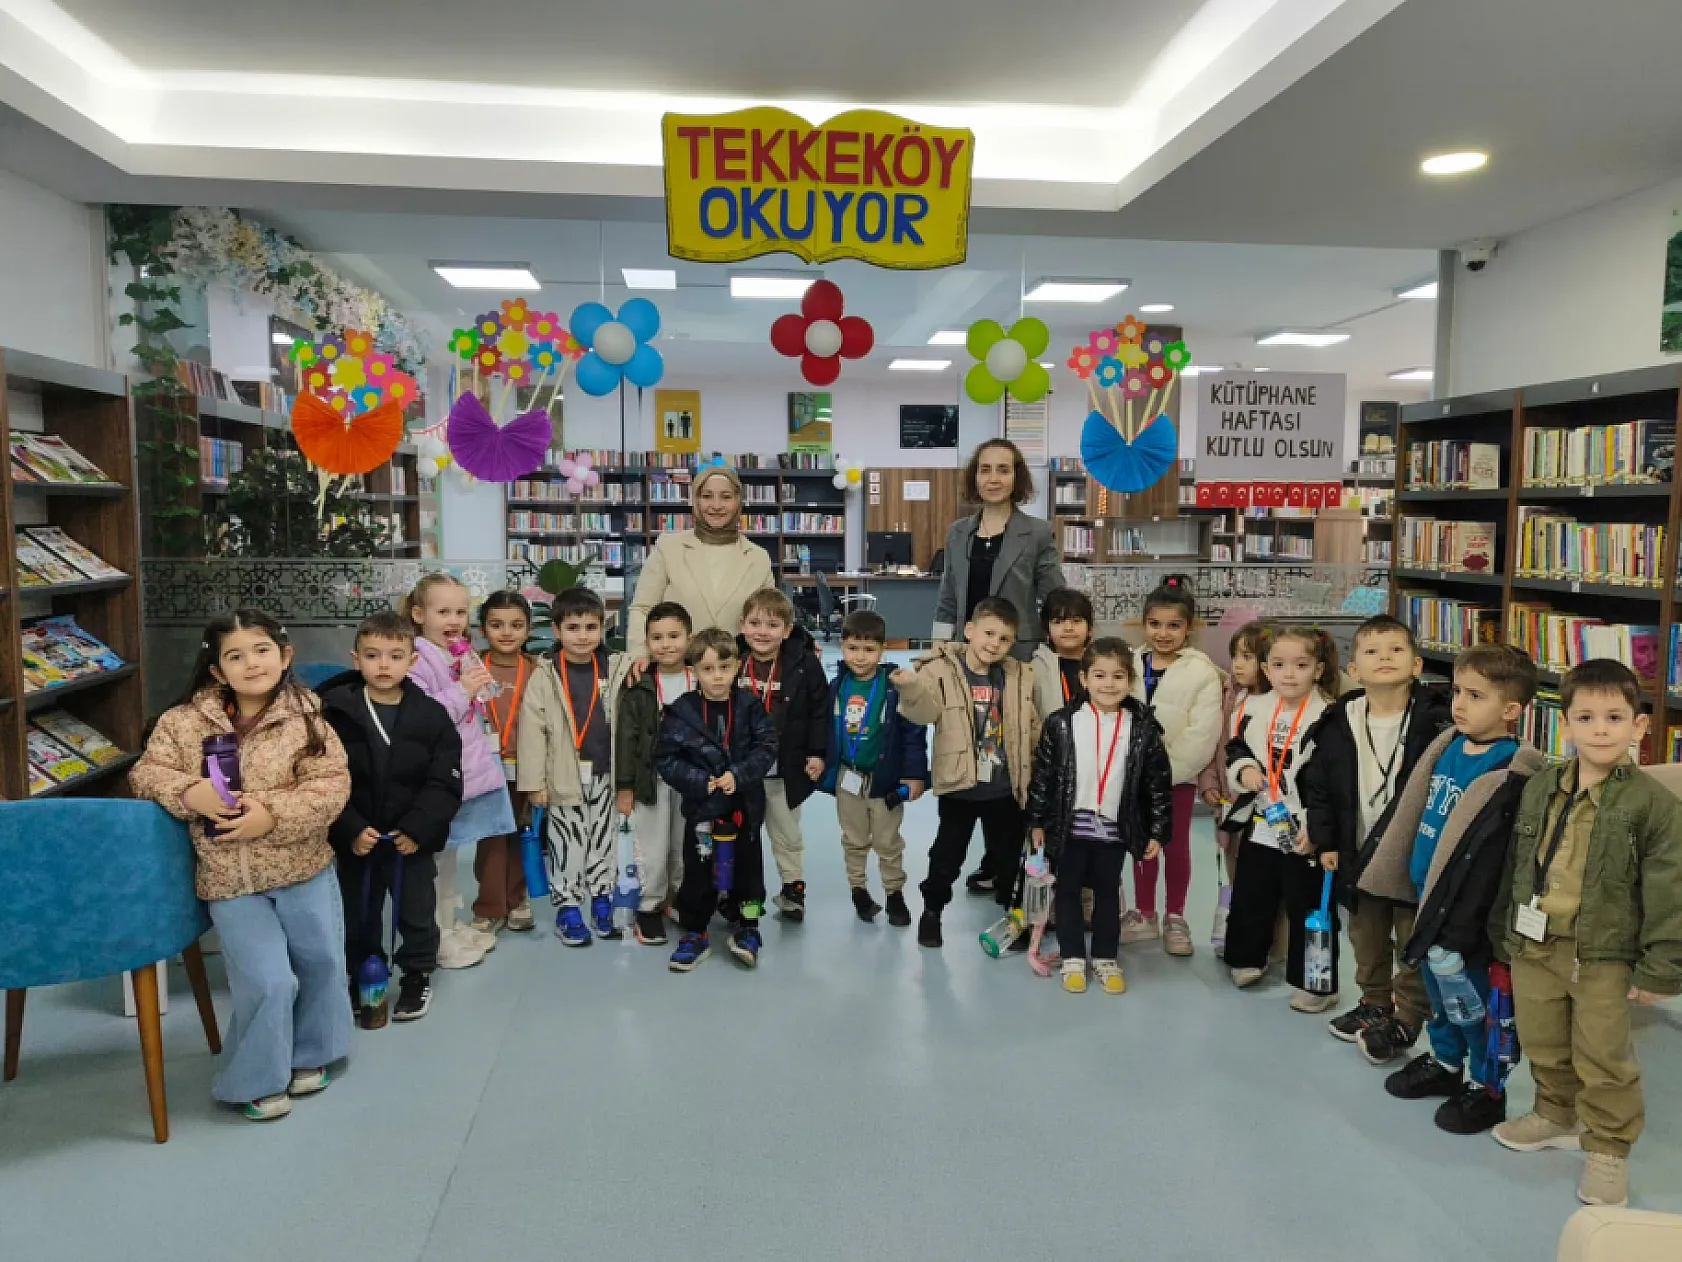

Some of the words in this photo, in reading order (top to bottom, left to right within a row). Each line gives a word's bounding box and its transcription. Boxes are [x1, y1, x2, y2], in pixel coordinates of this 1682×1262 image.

[677, 125, 965, 189] TEKKEKÖY
[699, 187, 929, 245] OKUYOR
[1210, 380, 1317, 406] KÜTÜPHANE
[1221, 409, 1301, 431] HAFTASI
[1206, 435, 1265, 457] KUTLU
[1274, 439, 1334, 459] OLSUN
